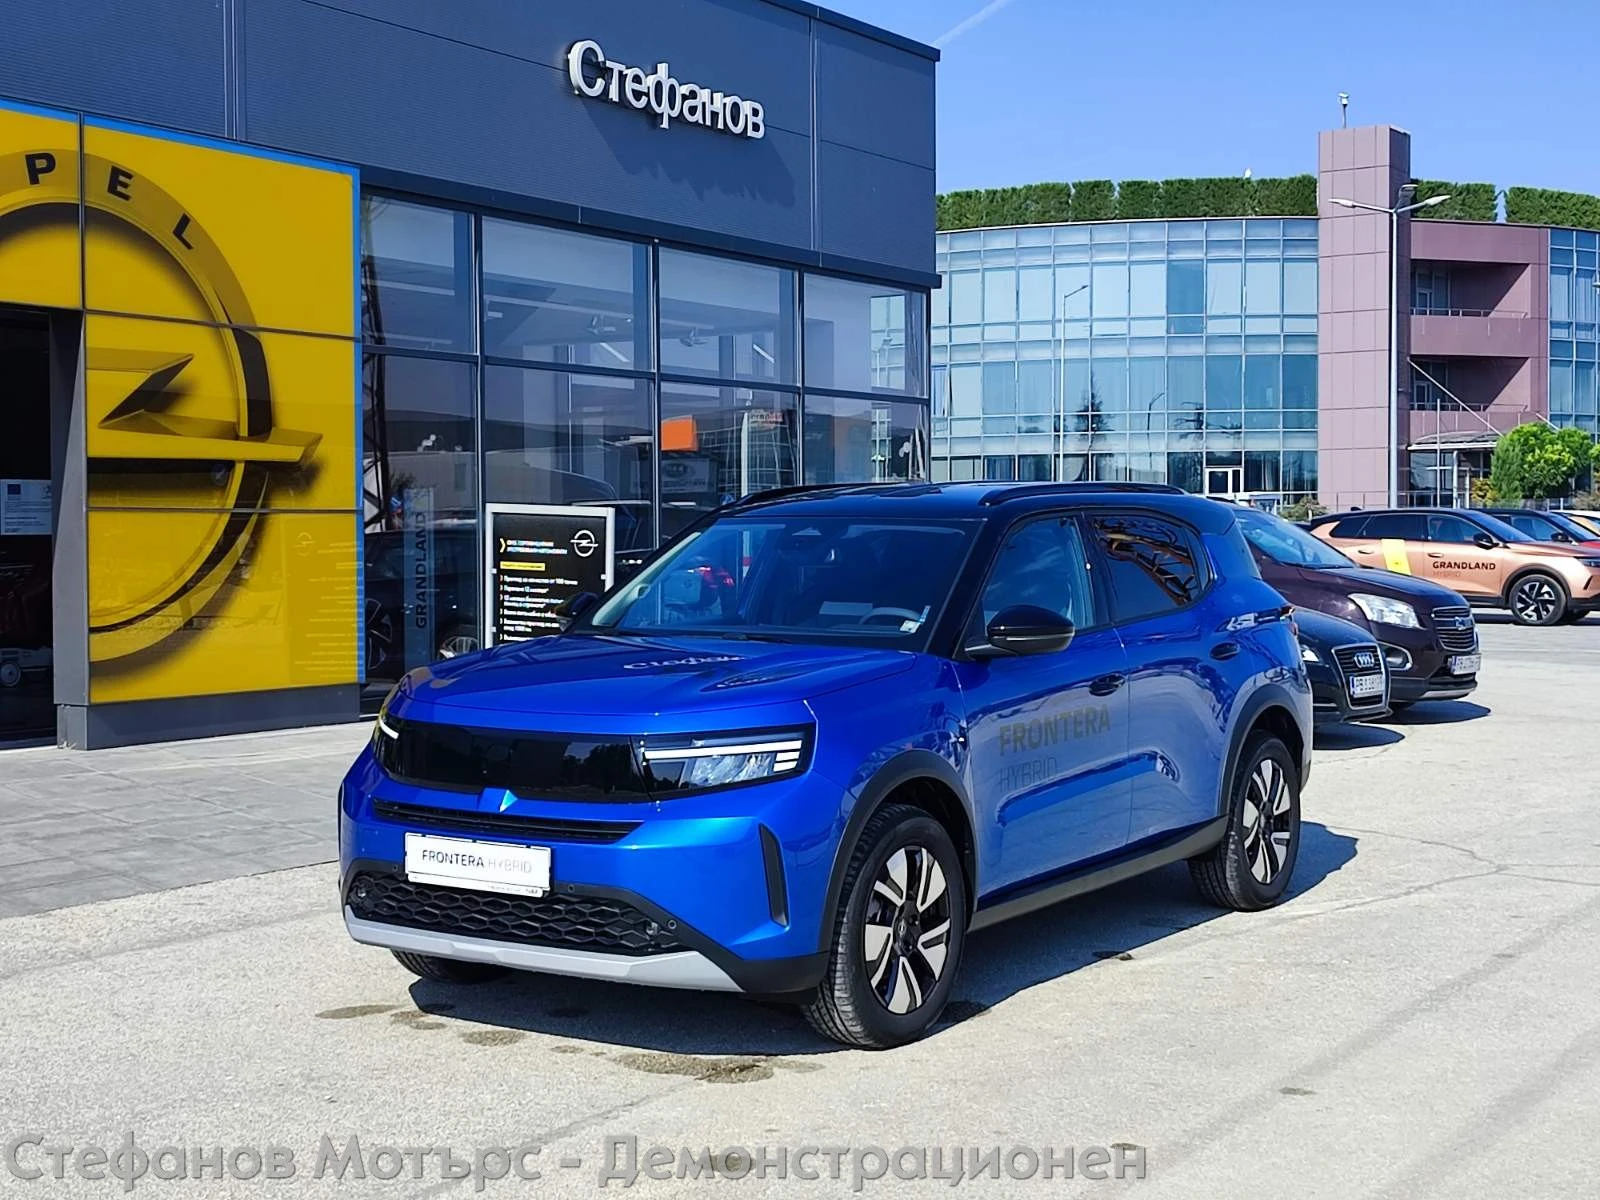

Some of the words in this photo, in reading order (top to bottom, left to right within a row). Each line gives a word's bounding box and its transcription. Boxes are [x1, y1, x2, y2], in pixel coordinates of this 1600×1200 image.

[567, 40, 766, 139] Стефанов
[415, 511, 428, 629] GRANDLAND
[1432, 561, 1497, 570] GRANDLAND
[1000, 704, 1110, 756] FRONTERA
[1000, 757, 1058, 792] HYBRID
[422, 850, 484, 868] FRONTERA
[488, 858, 533, 874] HYBRID
